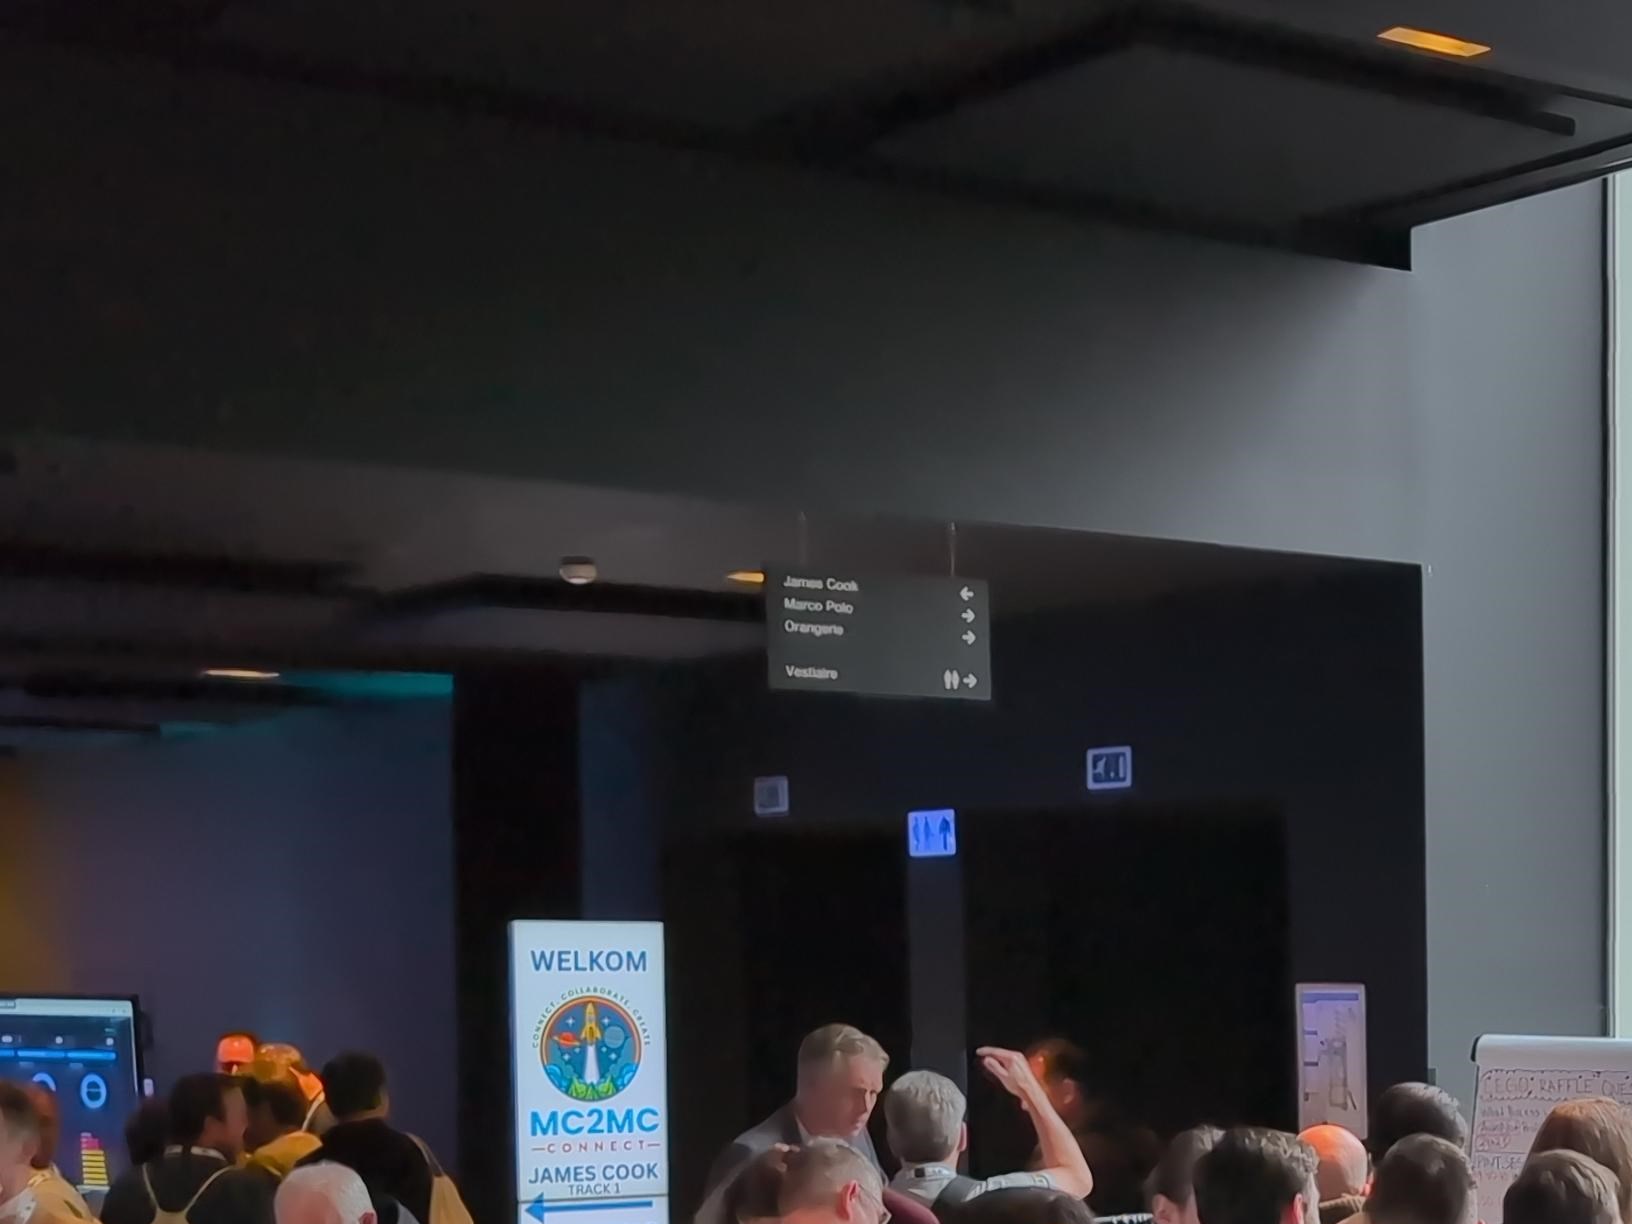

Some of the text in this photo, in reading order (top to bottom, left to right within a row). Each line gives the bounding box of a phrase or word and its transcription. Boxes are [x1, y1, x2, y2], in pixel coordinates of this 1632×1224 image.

[783, 575, 859, 591] James Cook
[784, 597, 854, 615] Marco Polo
[784, 619, 844, 637] Orangerie
[785, 664, 838, 679] Vestiaire
[530, 949, 648, 972] WELKOM
[1539, 1077, 1593, 1094] RAFFLE
[530, 1108, 660, 1137] MC2MC
[547, 1140, 644, 1154] CONNECT
[528, 1162, 659, 1184] JAMES COOK
[568, 1182, 621, 1196] TRACK 1
